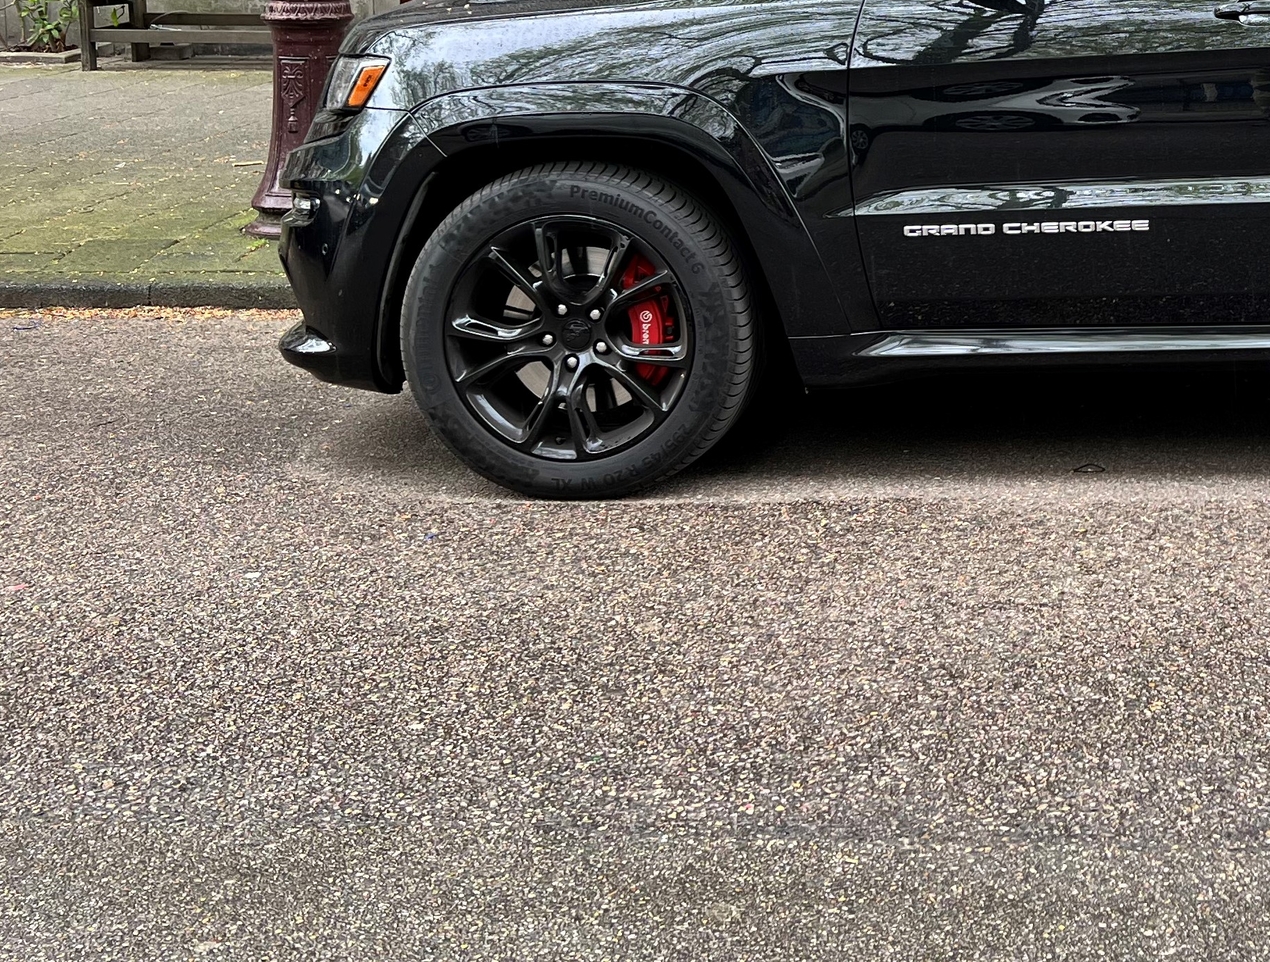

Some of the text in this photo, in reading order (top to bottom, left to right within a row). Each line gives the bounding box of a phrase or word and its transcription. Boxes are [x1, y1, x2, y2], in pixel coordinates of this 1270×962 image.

[903, 219, 1150, 237] GRAND CHEROKEE
[691, 261, 706, 275] 6
